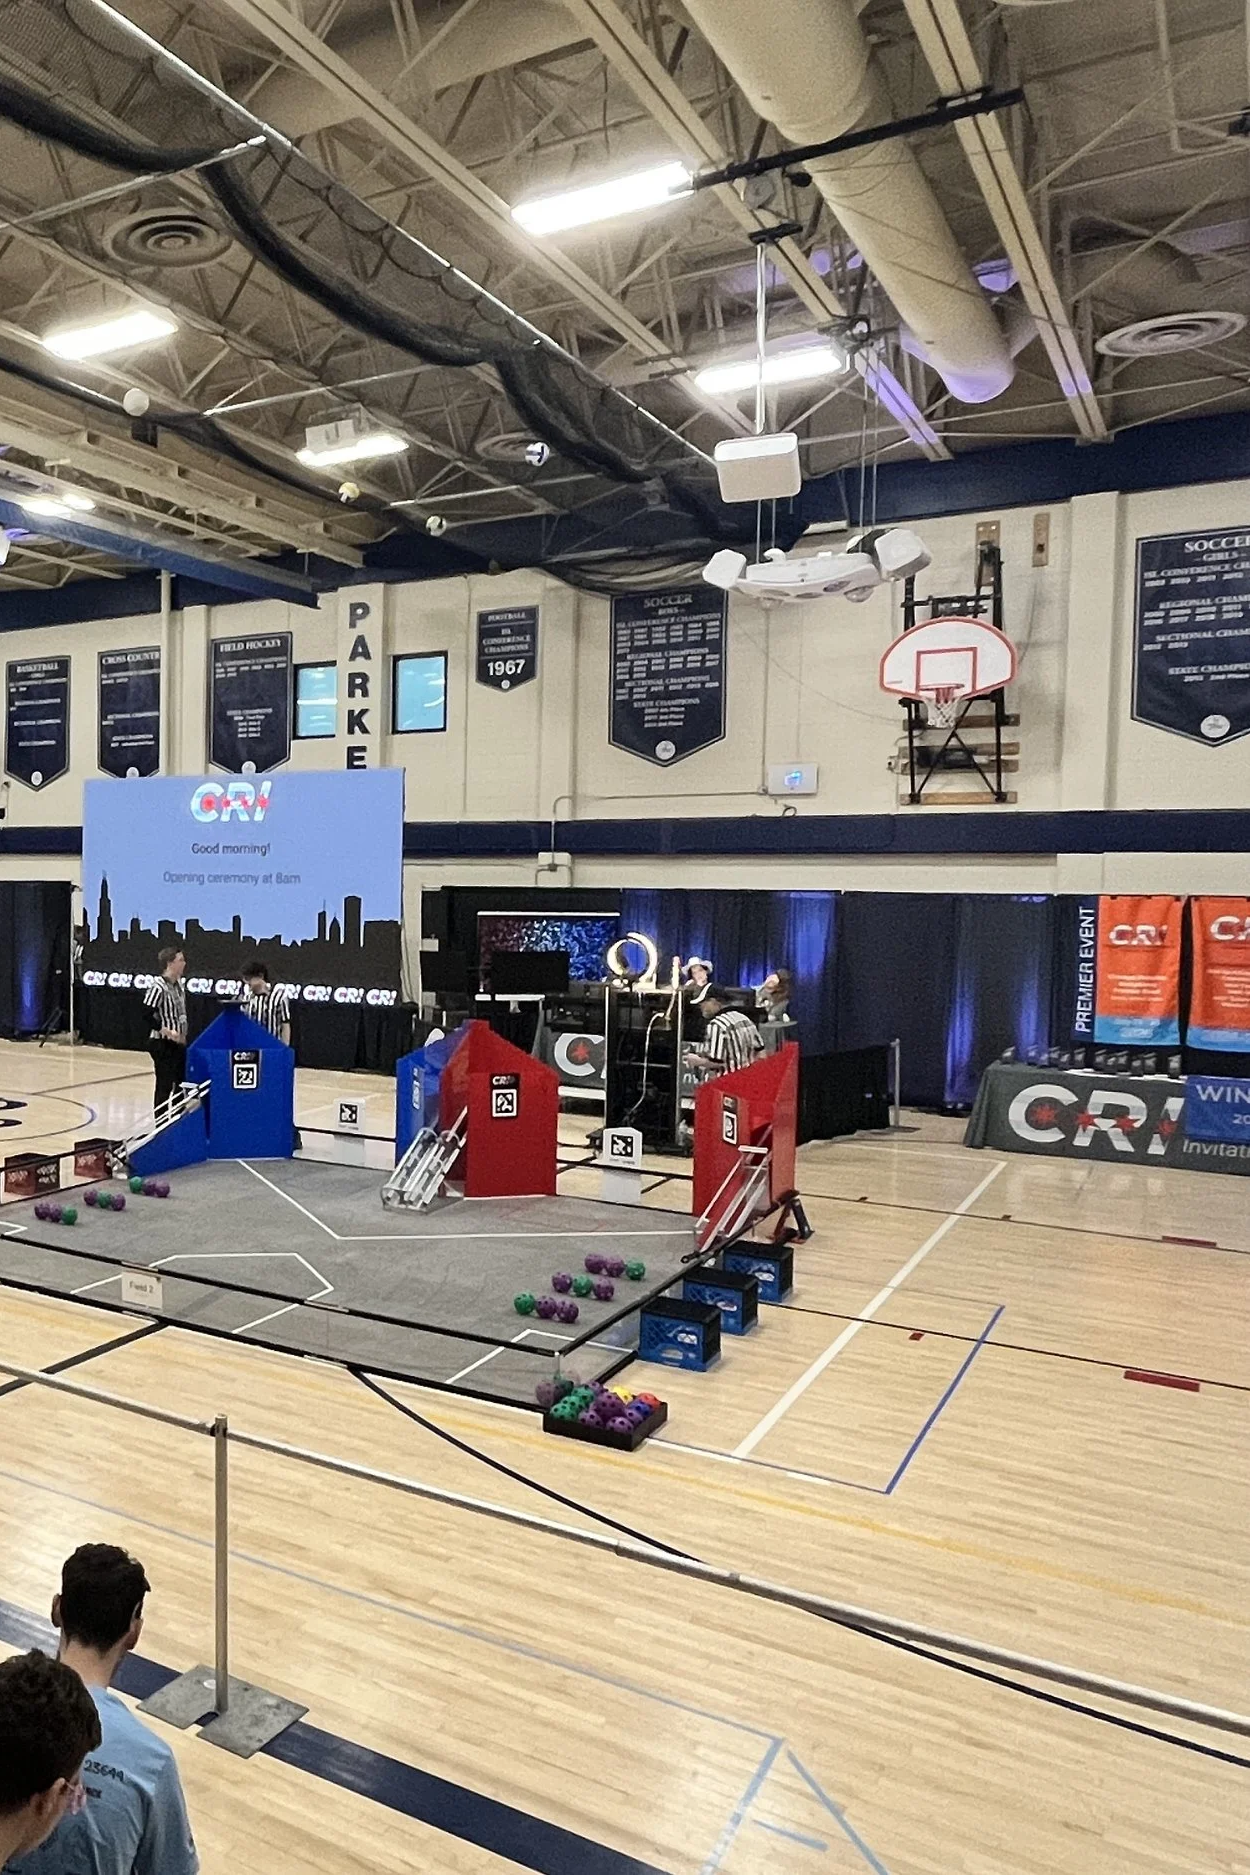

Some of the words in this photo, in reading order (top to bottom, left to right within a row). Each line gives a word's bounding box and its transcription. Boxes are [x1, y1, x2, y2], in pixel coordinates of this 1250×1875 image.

[1203, 552, 1239, 561] GIRLS
[644, 594, 693, 608] SOCCER
[220, 642, 244, 652] FIELD
[246, 639, 281, 650] HOCKEY
[484, 644, 529, 654] CHAMPIONS
[102, 655, 126, 665] CROSS
[127, 651, 160, 662] COUNTR
[487, 659, 525, 676] 1967
[347, 602, 372, 770] PARKE
[191, 843, 219, 855] Good
[222, 843, 271, 857] morning!
[163, 872, 205, 885] Opening
[208, 874, 259, 886] ceremony
[262, 873, 272, 884] at
[1079, 906, 1096, 958] EVENT
[1075, 962, 1094, 1033] PREMIER
[1008, 1084, 1185, 1155] CRI
[84, 1759, 124, 1782] 23644
